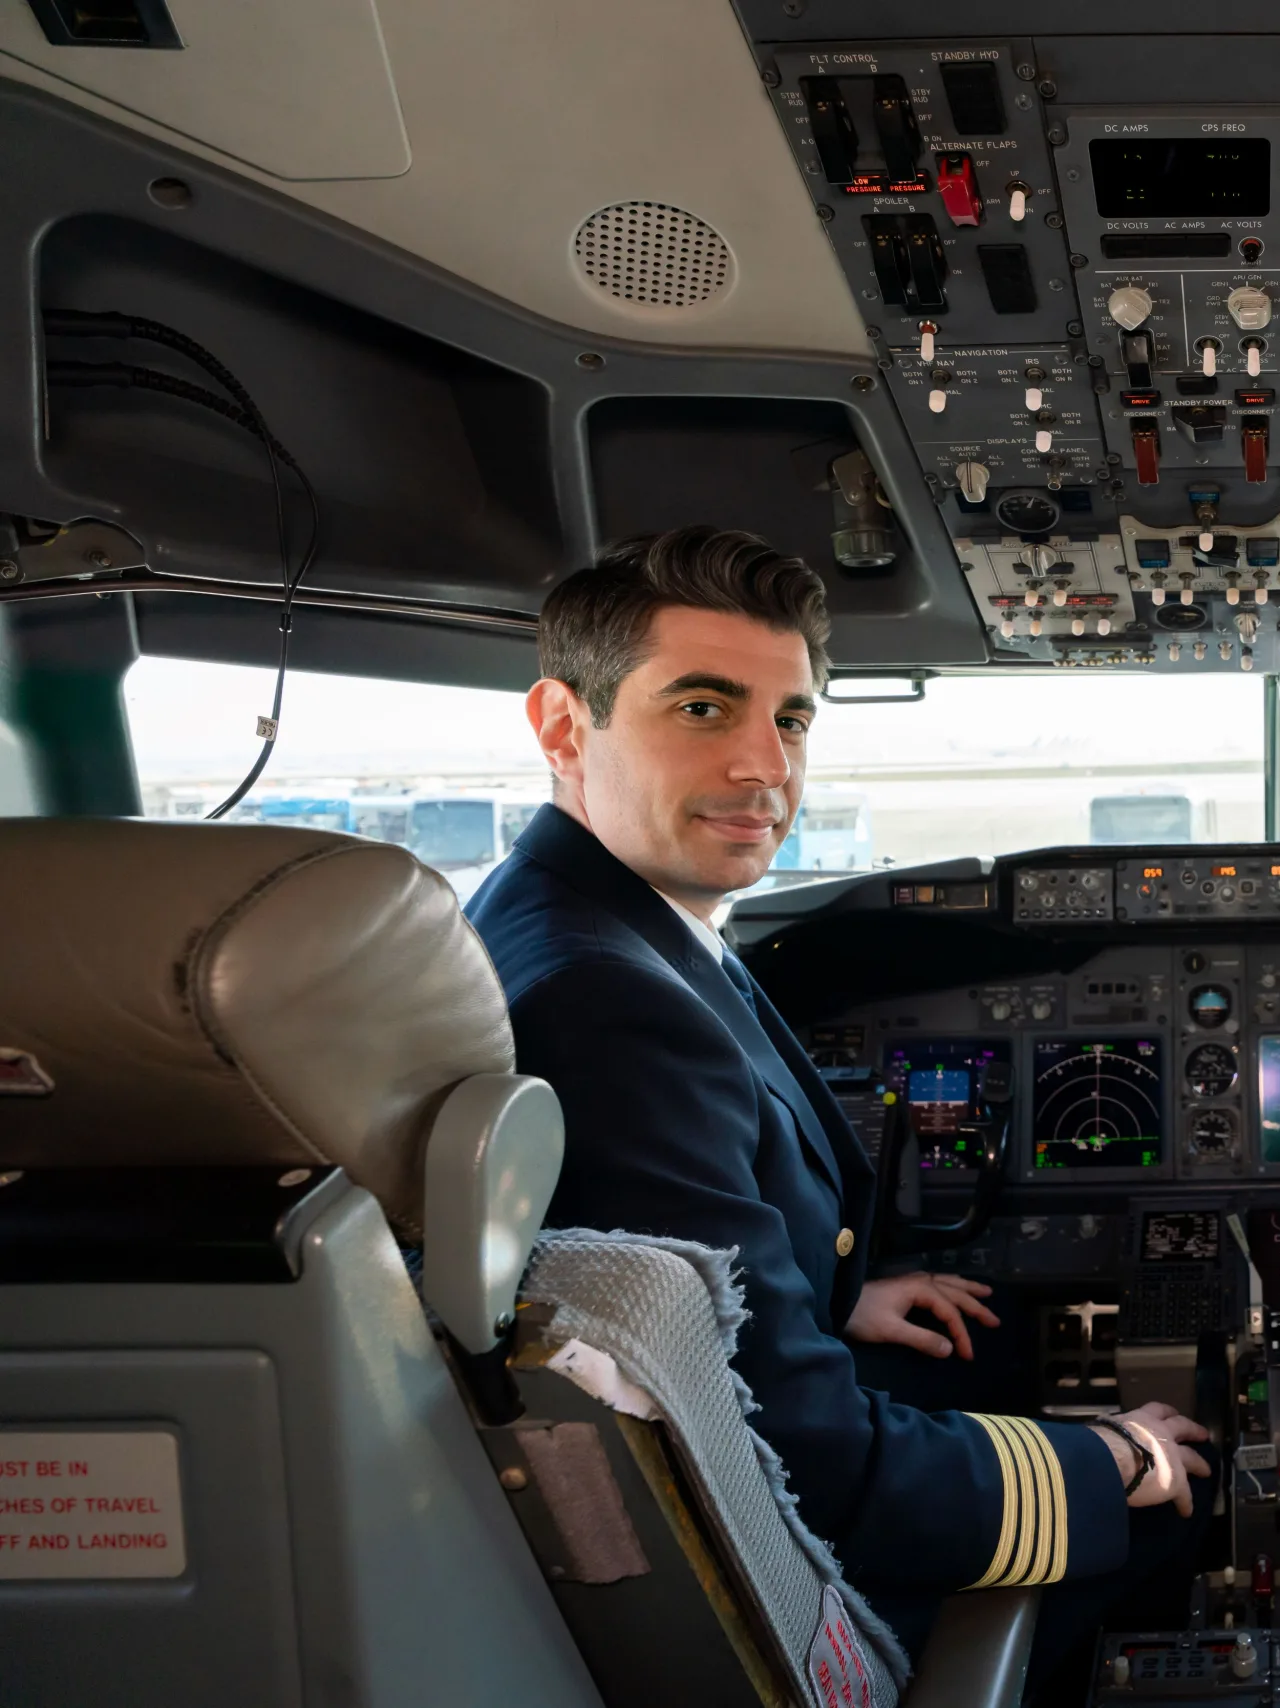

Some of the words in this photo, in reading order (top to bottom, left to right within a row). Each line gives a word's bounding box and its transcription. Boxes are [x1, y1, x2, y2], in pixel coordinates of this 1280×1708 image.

[810, 54, 830, 63] FLT
[833, 54, 878, 63] CONTROL
[931, 51, 975, 61] STANDBY
[980, 51, 999, 60] HYD
[1105, 124, 1118, 132] DC
[1122, 124, 1149, 132] AMPS
[1201, 123, 1218, 132] CPS
[1221, 123, 1246, 132] FREQ
[930, 142, 983, 151] ALTERNATE
[987, 140, 1017, 150] FLAPS
[846, 185, 882, 193] PRESSURE
[889, 184, 925, 192] PRESSURE
[873, 197, 909, 206] SPOILER
[1123, 221, 1149, 229] VOLTS
[1164, 221, 1177, 229] AC
[1182, 221, 1205, 229] AMPS
[1221, 221, 1233, 229] AC
[1237, 220, 1262, 229] VOLTS
[36, 1461, 62, 1476] BE
[69, 1461, 88, 1476] IN
[51, 1498, 77, 1513] OF
[85, 1498, 161, 1513] TRAVEL
[28, 1534, 70, 1549] AND
[78, 1533, 167, 1549] LANDING
